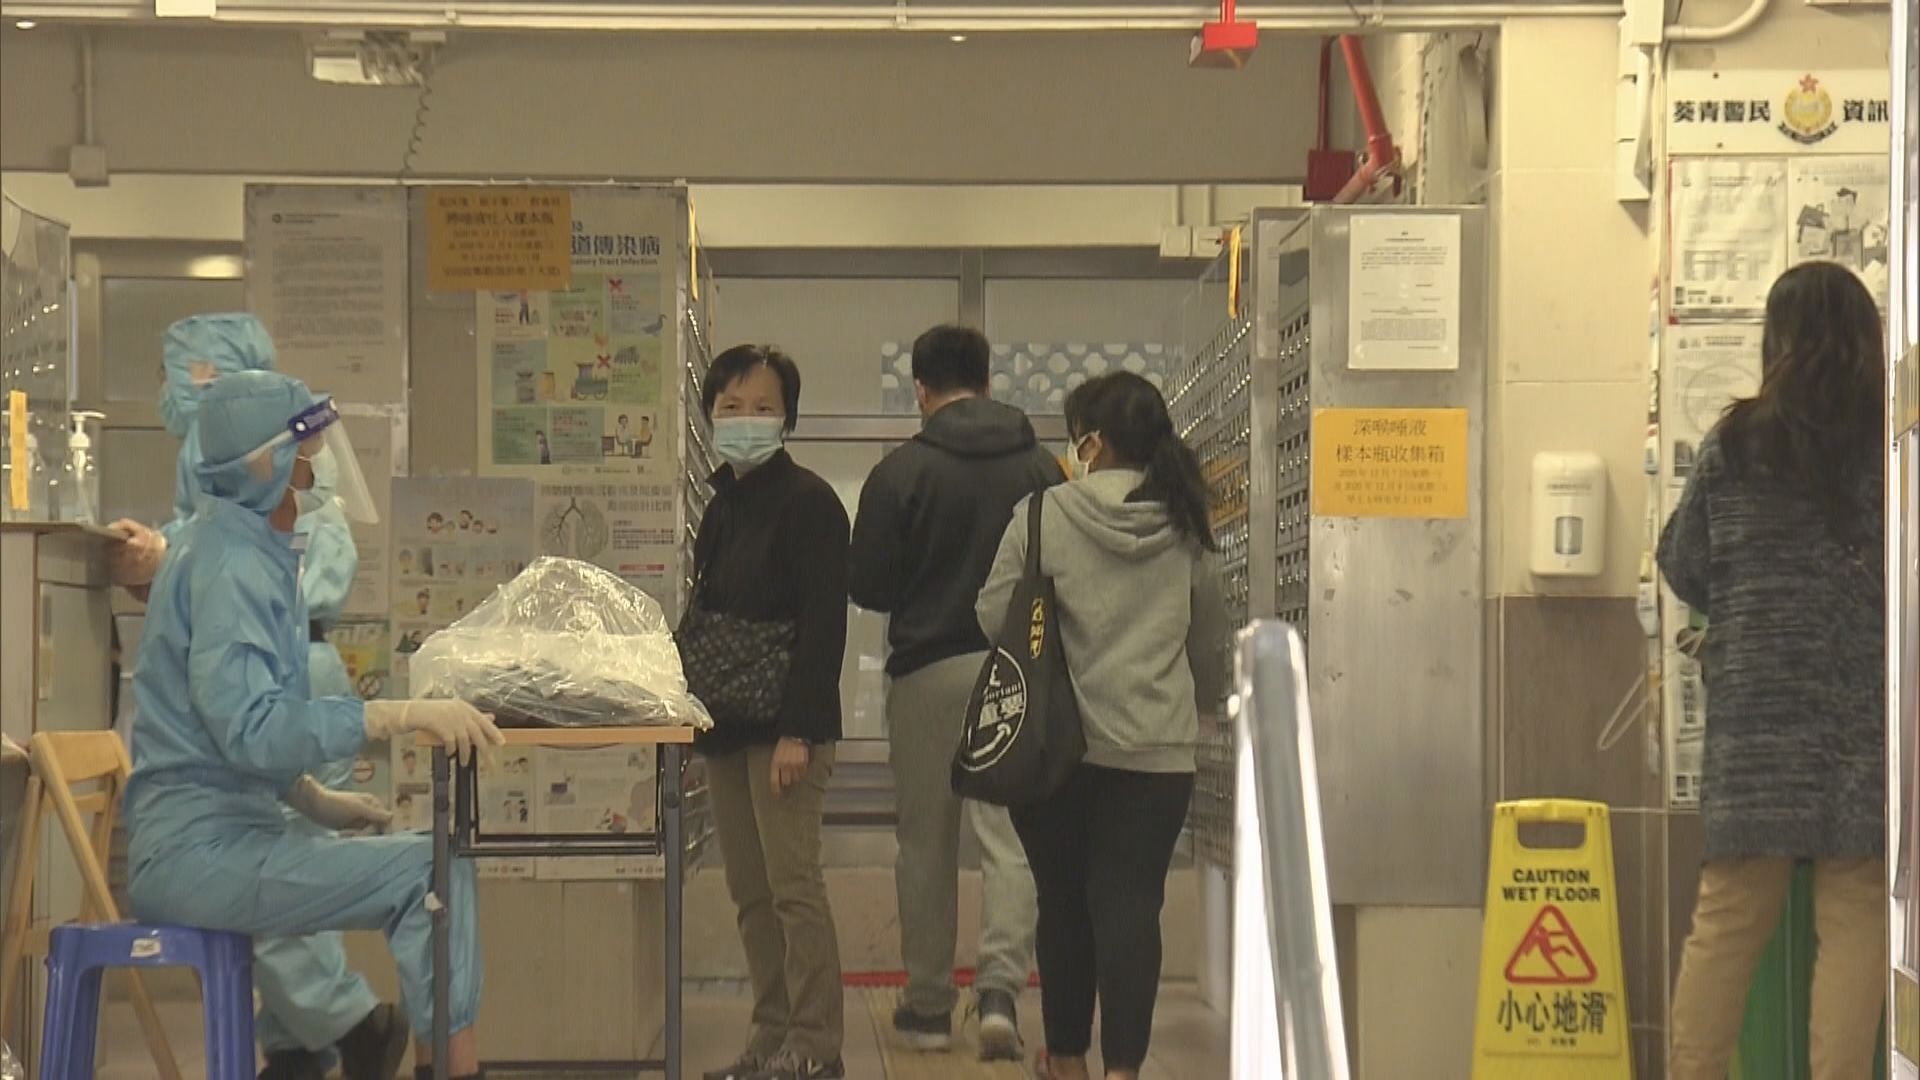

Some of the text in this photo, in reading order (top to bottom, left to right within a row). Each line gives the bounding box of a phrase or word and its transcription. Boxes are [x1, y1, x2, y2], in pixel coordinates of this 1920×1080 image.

[1673, 100, 1889, 123] 葵青警民 資訊
[620, 258, 658, 266] Infection
[1336, 443, 1446, 464] 樣本瓶收集箱
[1512, 868, 1590, 884] CAUTION
[1502, 886, 1601, 902] WET FLOOR
[1497, 989, 1608, 1035] 小心地滑
